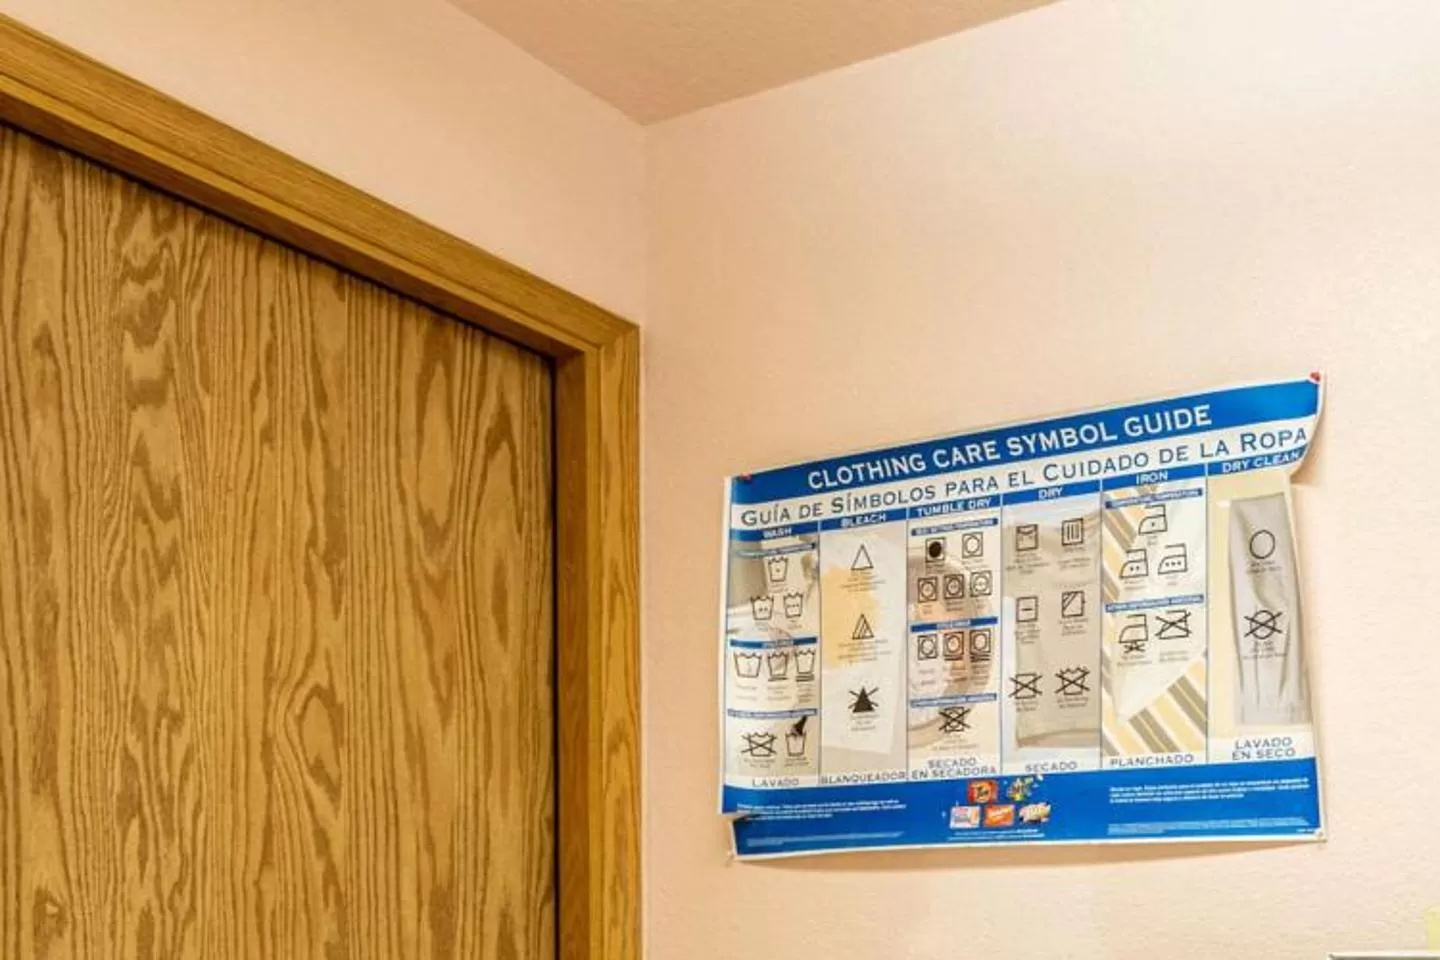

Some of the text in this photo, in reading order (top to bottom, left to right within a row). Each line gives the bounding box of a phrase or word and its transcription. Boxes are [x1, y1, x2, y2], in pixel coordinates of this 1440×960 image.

[807, 404, 1213, 490] CLOTHING CARE SYMBOL GUIDE
[1222, 451, 1301, 474] DRY CLEAN
[799, 502, 824, 520] DE
[945, 475, 1000, 497] PARA
[1008, 470, 1034, 489] EL
[1043, 452, 1149, 481] CUIDADO
[1159, 444, 1189, 464] DE
[1200, 439, 1230, 458] LA
[1240, 427, 1307, 452] ROPA
[1136, 472, 1168, 485] IRON
[1038, 487, 1063, 500] DRY
[917, 496, 992, 518] TUMBLE DRY
[840, 512, 887, 528] BLEACH
[763, 526, 793, 539] WASH
[1235, 736, 1293, 750] LAVADO
[1110, 752, 1195, 768] PLANCHADO
[1232, 747, 1296, 761] EN SECO
[928, 757, 976, 770] SECADO
[1025, 760, 1078, 773] SECADO
[820, 770, 907, 786] BLANQUEADOR
[911, 766, 998, 781] EN SECADORA
[752, 776, 800, 788] LAVADO
